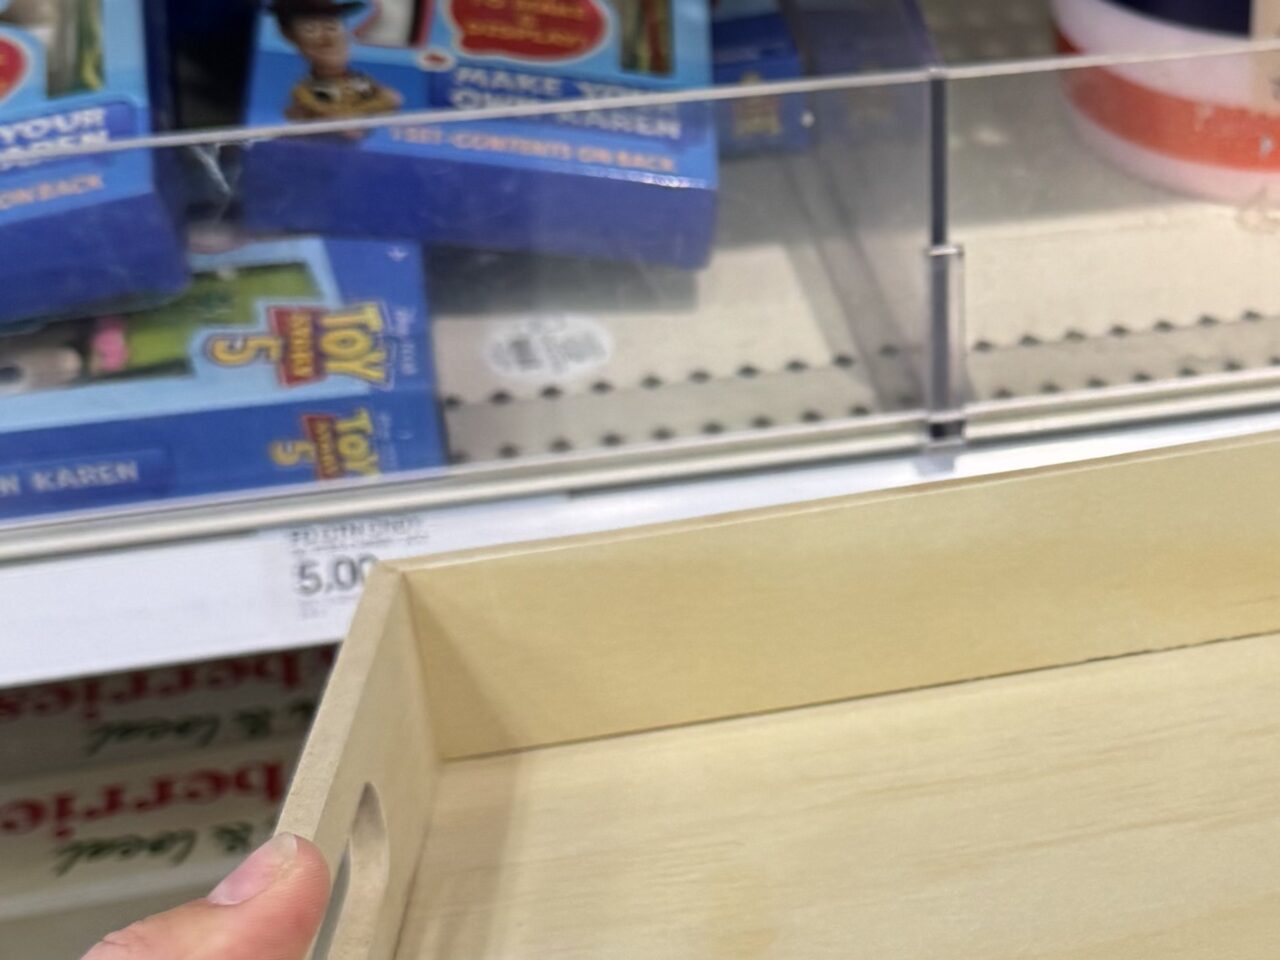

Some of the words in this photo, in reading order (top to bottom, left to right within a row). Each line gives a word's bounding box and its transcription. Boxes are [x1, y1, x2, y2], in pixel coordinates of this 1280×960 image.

[455, 66, 563, 97] MAKE
[205, 334, 283, 367] 5
[319, 304, 387, 384] TOY
[32, 460, 138, 492] KAREN
